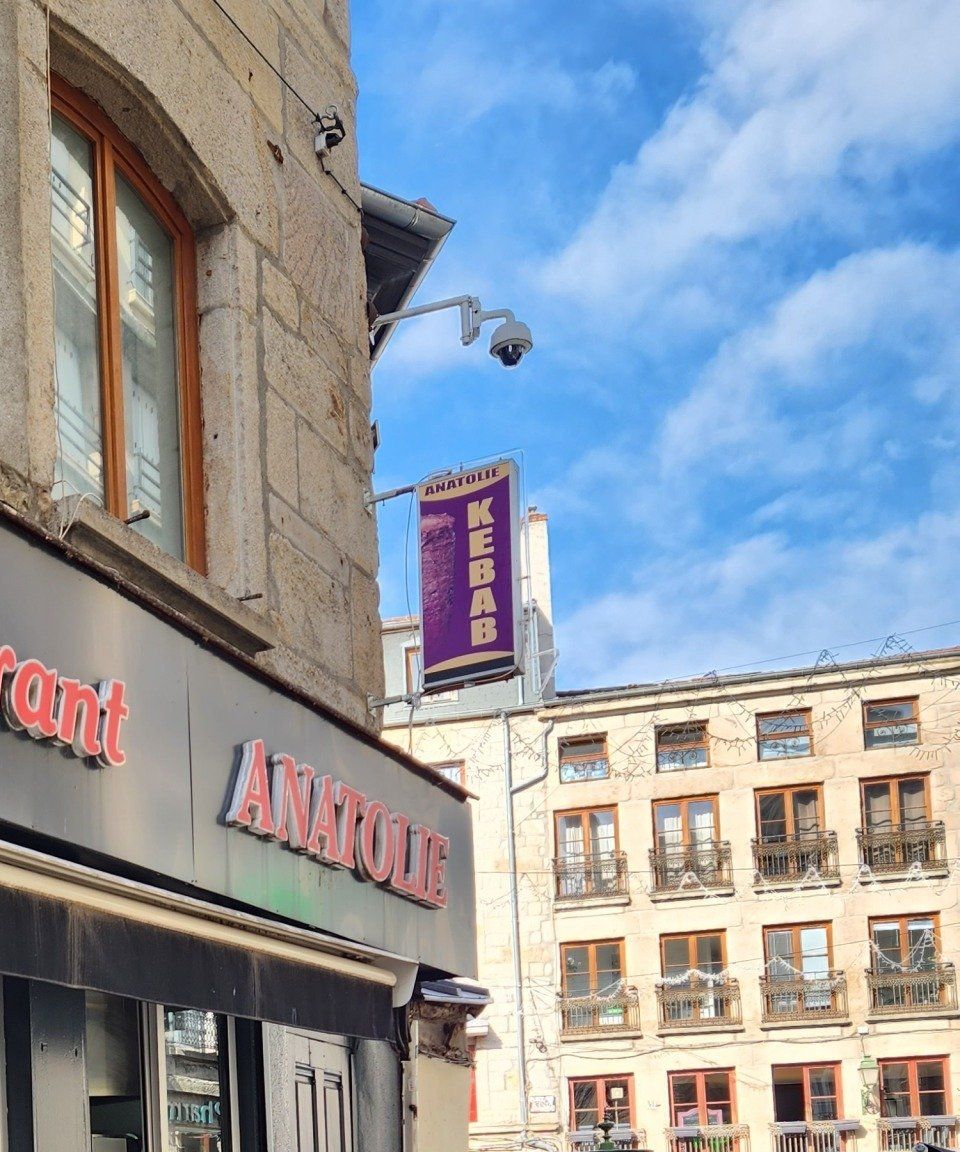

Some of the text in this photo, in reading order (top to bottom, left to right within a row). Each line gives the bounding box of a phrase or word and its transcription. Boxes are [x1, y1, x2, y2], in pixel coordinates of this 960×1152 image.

[424, 466, 500, 496] ANATOLIE
[467, 497, 498, 646] KEBAB
[230, 738, 450, 908] ANATOLIE
